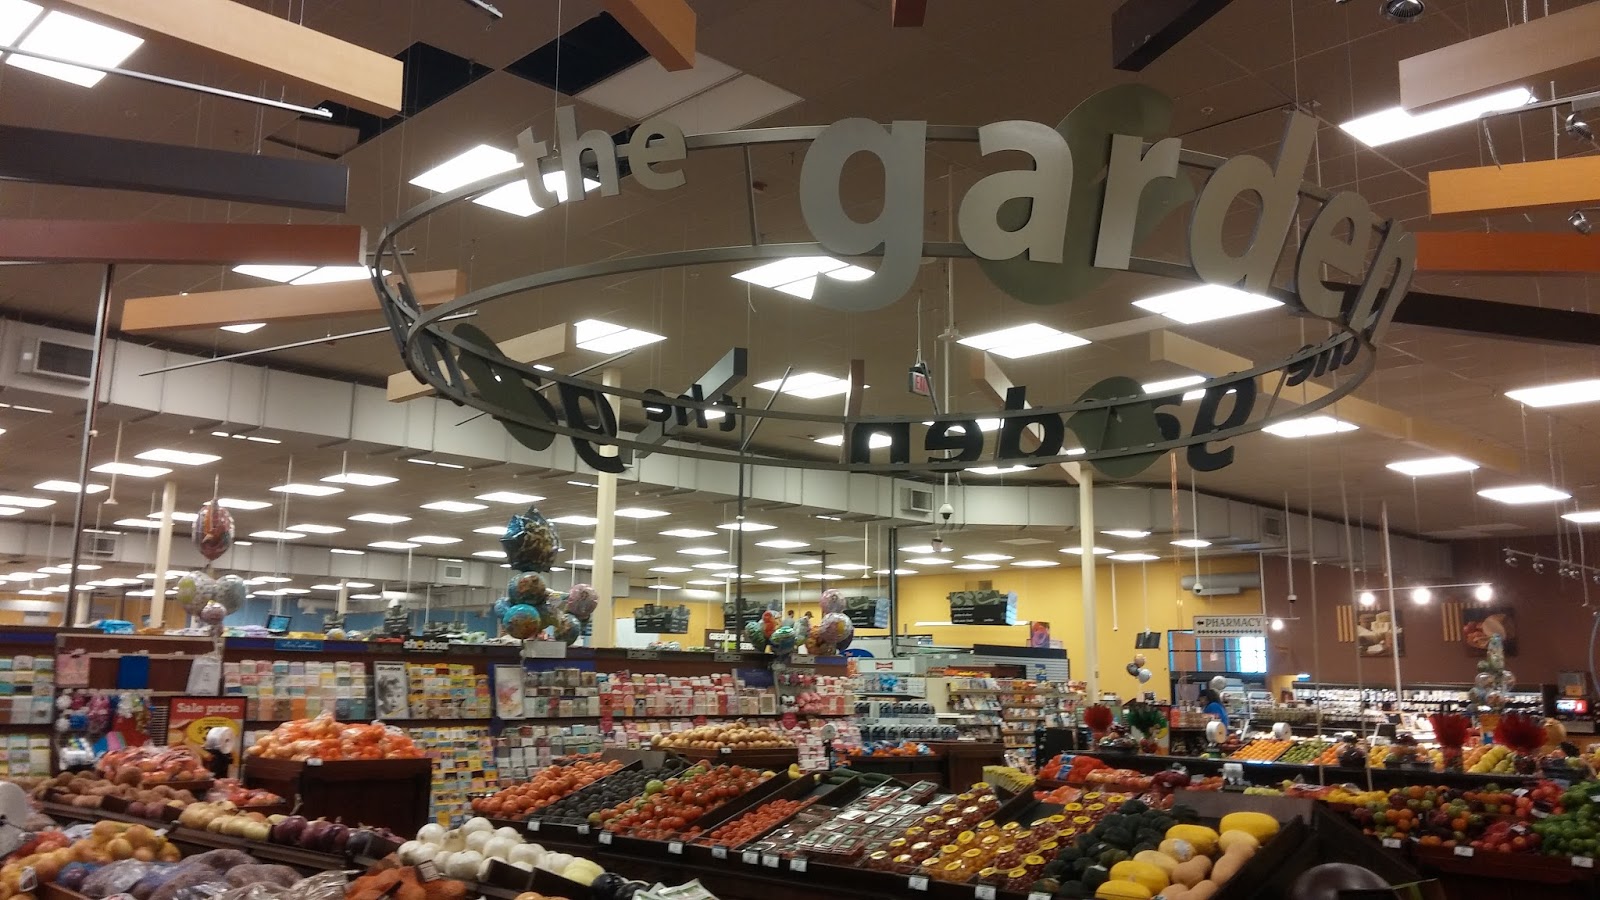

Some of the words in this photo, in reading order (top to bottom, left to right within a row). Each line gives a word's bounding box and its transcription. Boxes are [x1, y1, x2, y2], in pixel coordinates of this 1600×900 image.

[517, 105, 688, 208] the
[800, 109, 1416, 347] garden
[1205, 617, 1262, 628] PHARMACY
[177, 702, 204, 713] Sale
[206, 702, 240, 716] price
